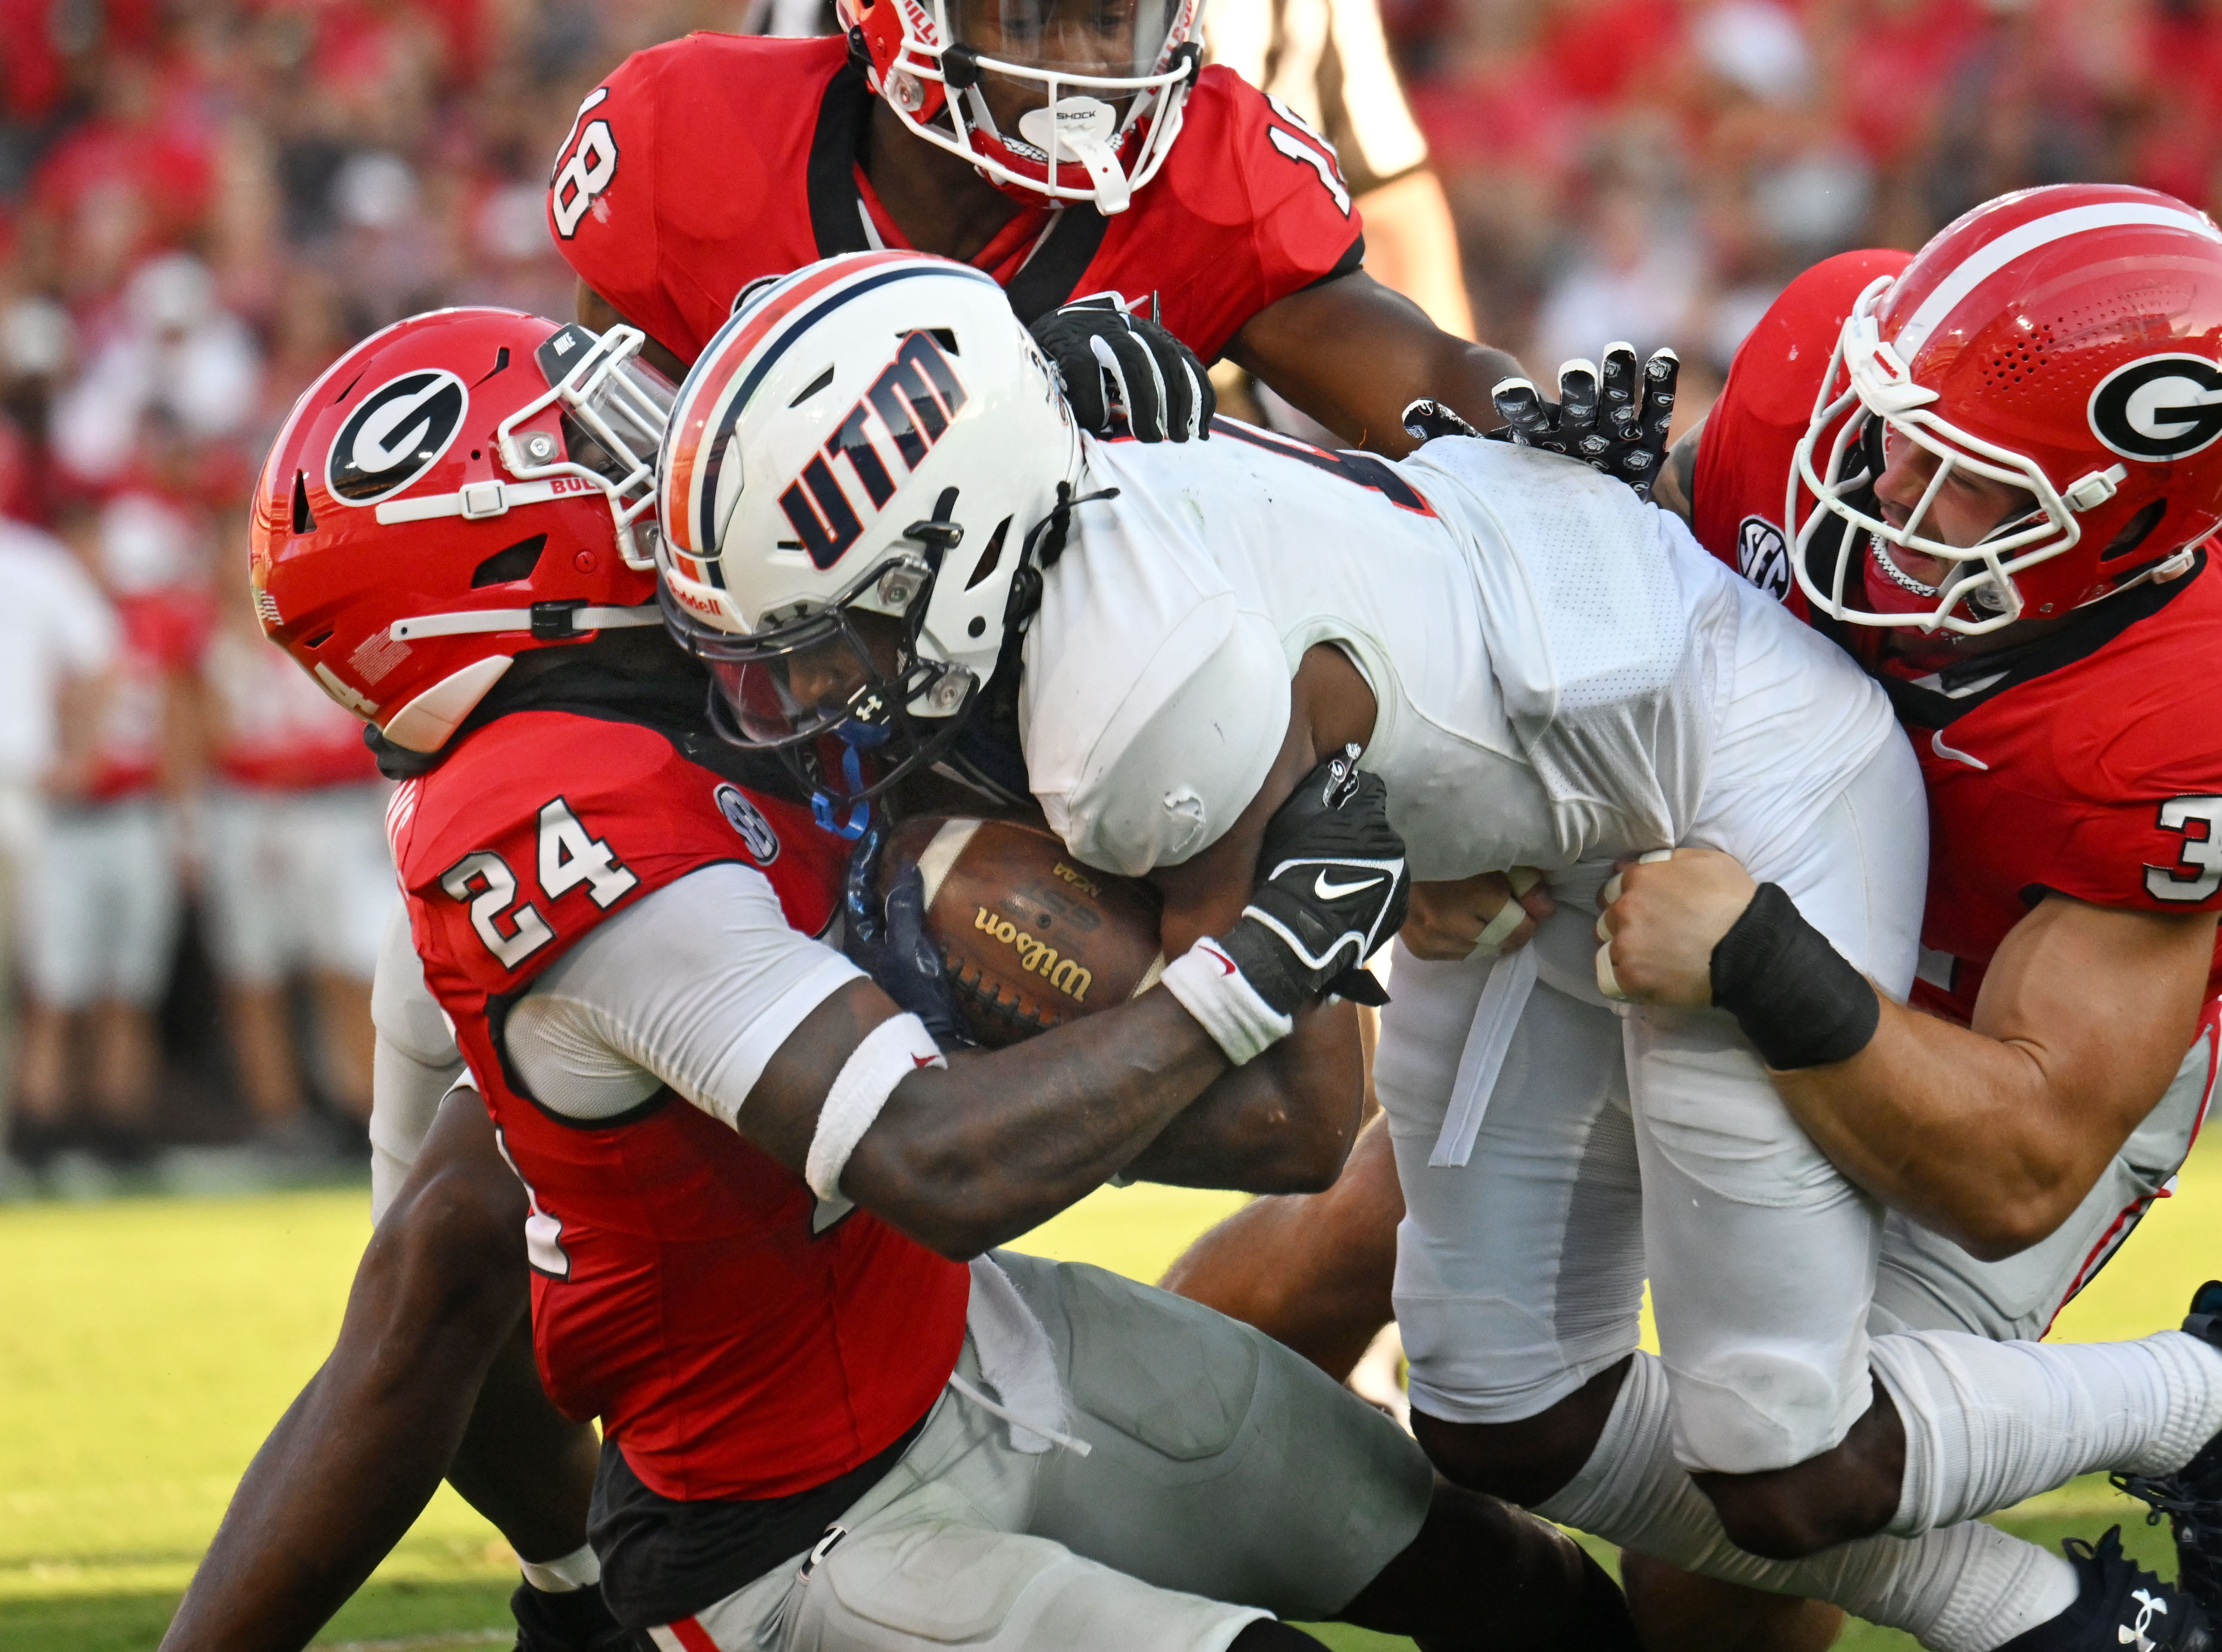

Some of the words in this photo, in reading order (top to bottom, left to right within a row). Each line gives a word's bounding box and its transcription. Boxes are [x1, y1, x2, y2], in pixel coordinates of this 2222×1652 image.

[1056, 110, 1096, 120] SHOCK
[553, 331, 576, 357] NIKE
[335, 372, 463, 493] G
[778, 330, 969, 570] UTM
[2108, 366, 2222, 451] G
[550, 478, 603, 494] BUL
[441, 795, 642, 973] 24
[2143, 793, 2222, 903] 3
[975, 906, 1092, 1003] Wilson
